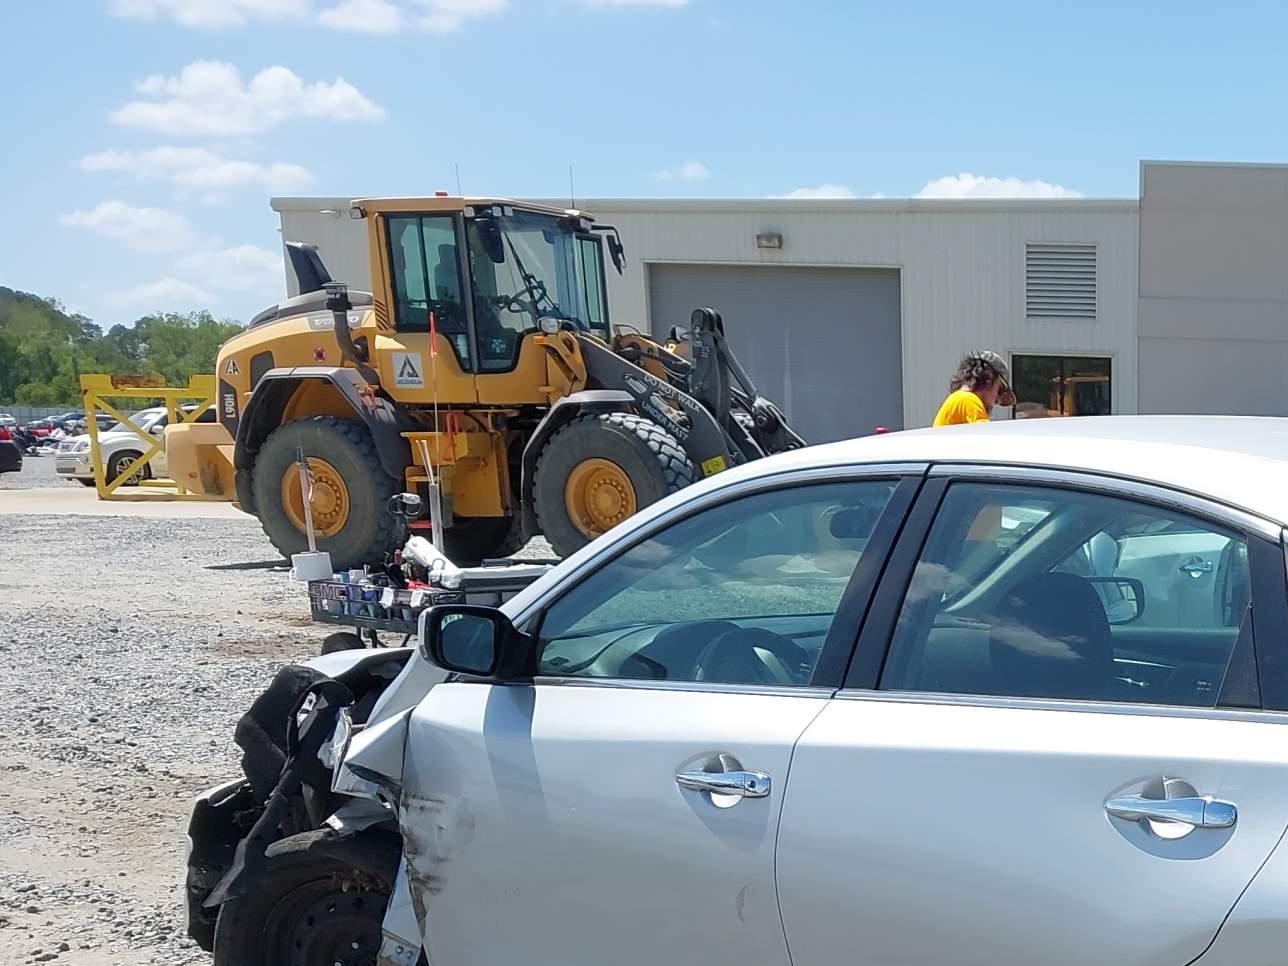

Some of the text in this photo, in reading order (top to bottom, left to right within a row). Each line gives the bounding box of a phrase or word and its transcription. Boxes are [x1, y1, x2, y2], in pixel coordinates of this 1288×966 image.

[314, 315, 360, 326] VOO
[644, 374, 701, 413] DO NOT WALK
[641, 401, 689, 441] UNDER MAST
